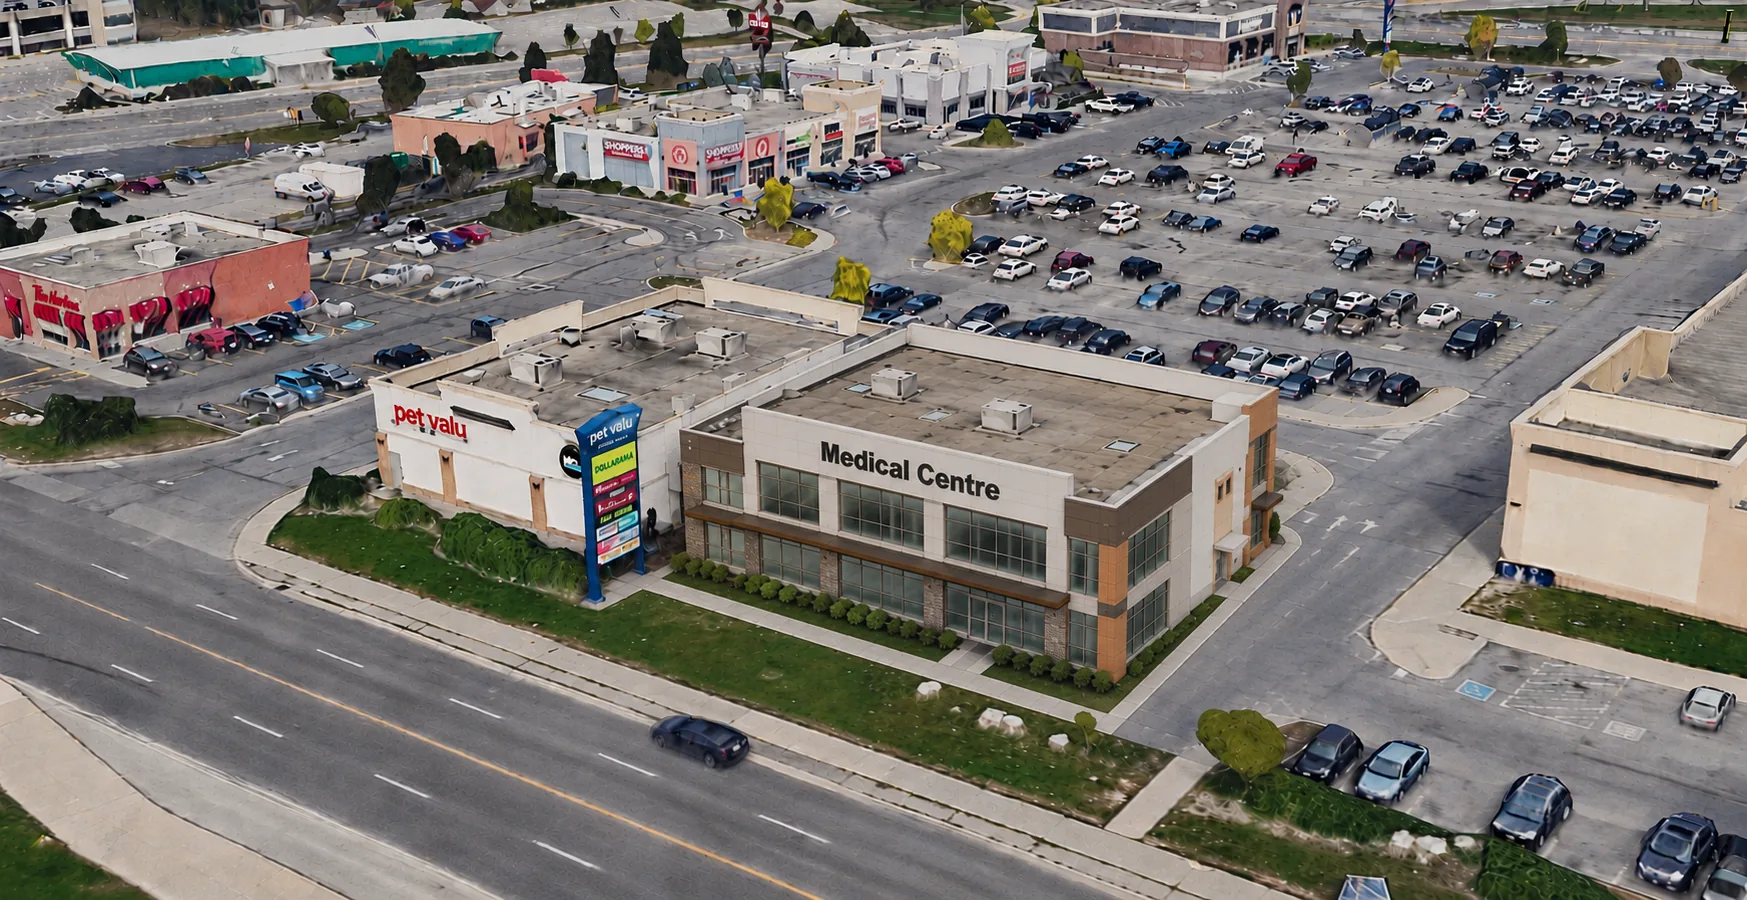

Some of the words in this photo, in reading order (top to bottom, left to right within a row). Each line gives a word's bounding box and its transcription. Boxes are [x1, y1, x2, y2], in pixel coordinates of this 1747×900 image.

[393, 404, 425, 426] pet
[427, 413, 468, 439] valu
[589, 426, 609, 446] pet
[609, 417, 633, 435] valu
[594, 451, 634, 474] DOLLARAMA
[820, 440, 910, 481] Medical
[917, 463, 1001, 501] Centre
